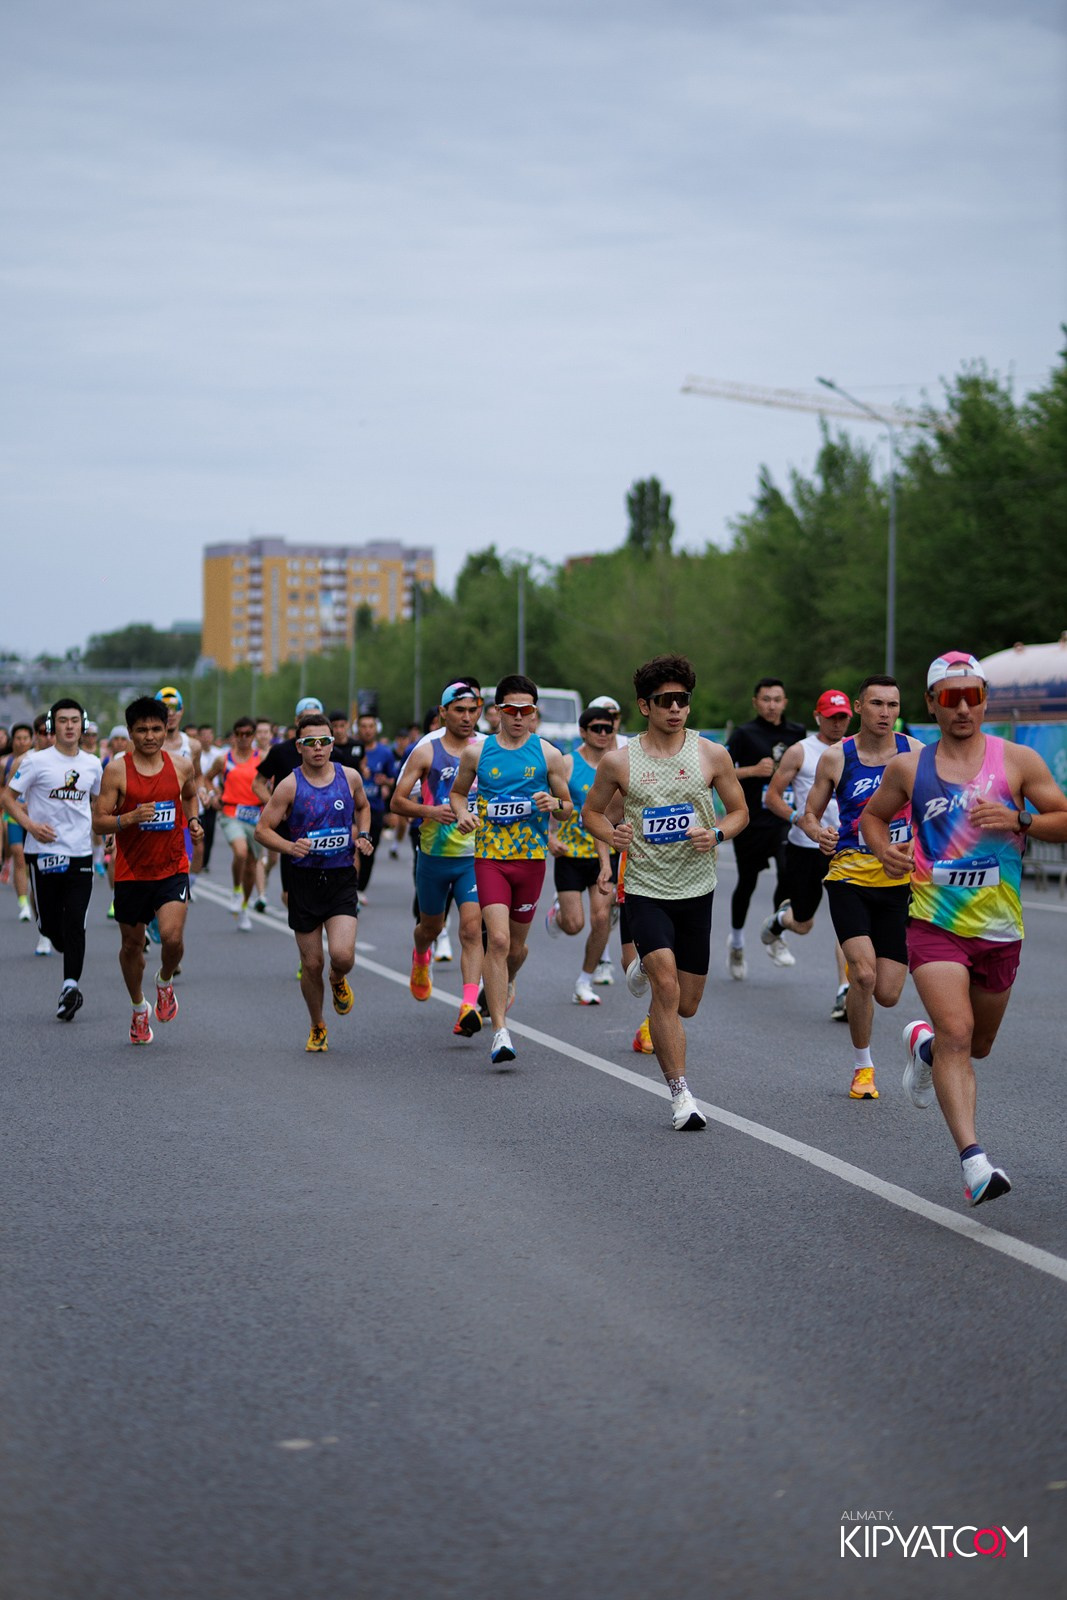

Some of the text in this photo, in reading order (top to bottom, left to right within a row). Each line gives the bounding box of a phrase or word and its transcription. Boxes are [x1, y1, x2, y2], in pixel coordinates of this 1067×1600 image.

[494, 803, 524, 817] 1516
[148, 811, 171, 823] 211
[648, 815, 690, 833] 1780
[313, 836, 345, 849] 1459
[43, 855, 66, 868] 1512
[949, 871, 987, 886] 1111
